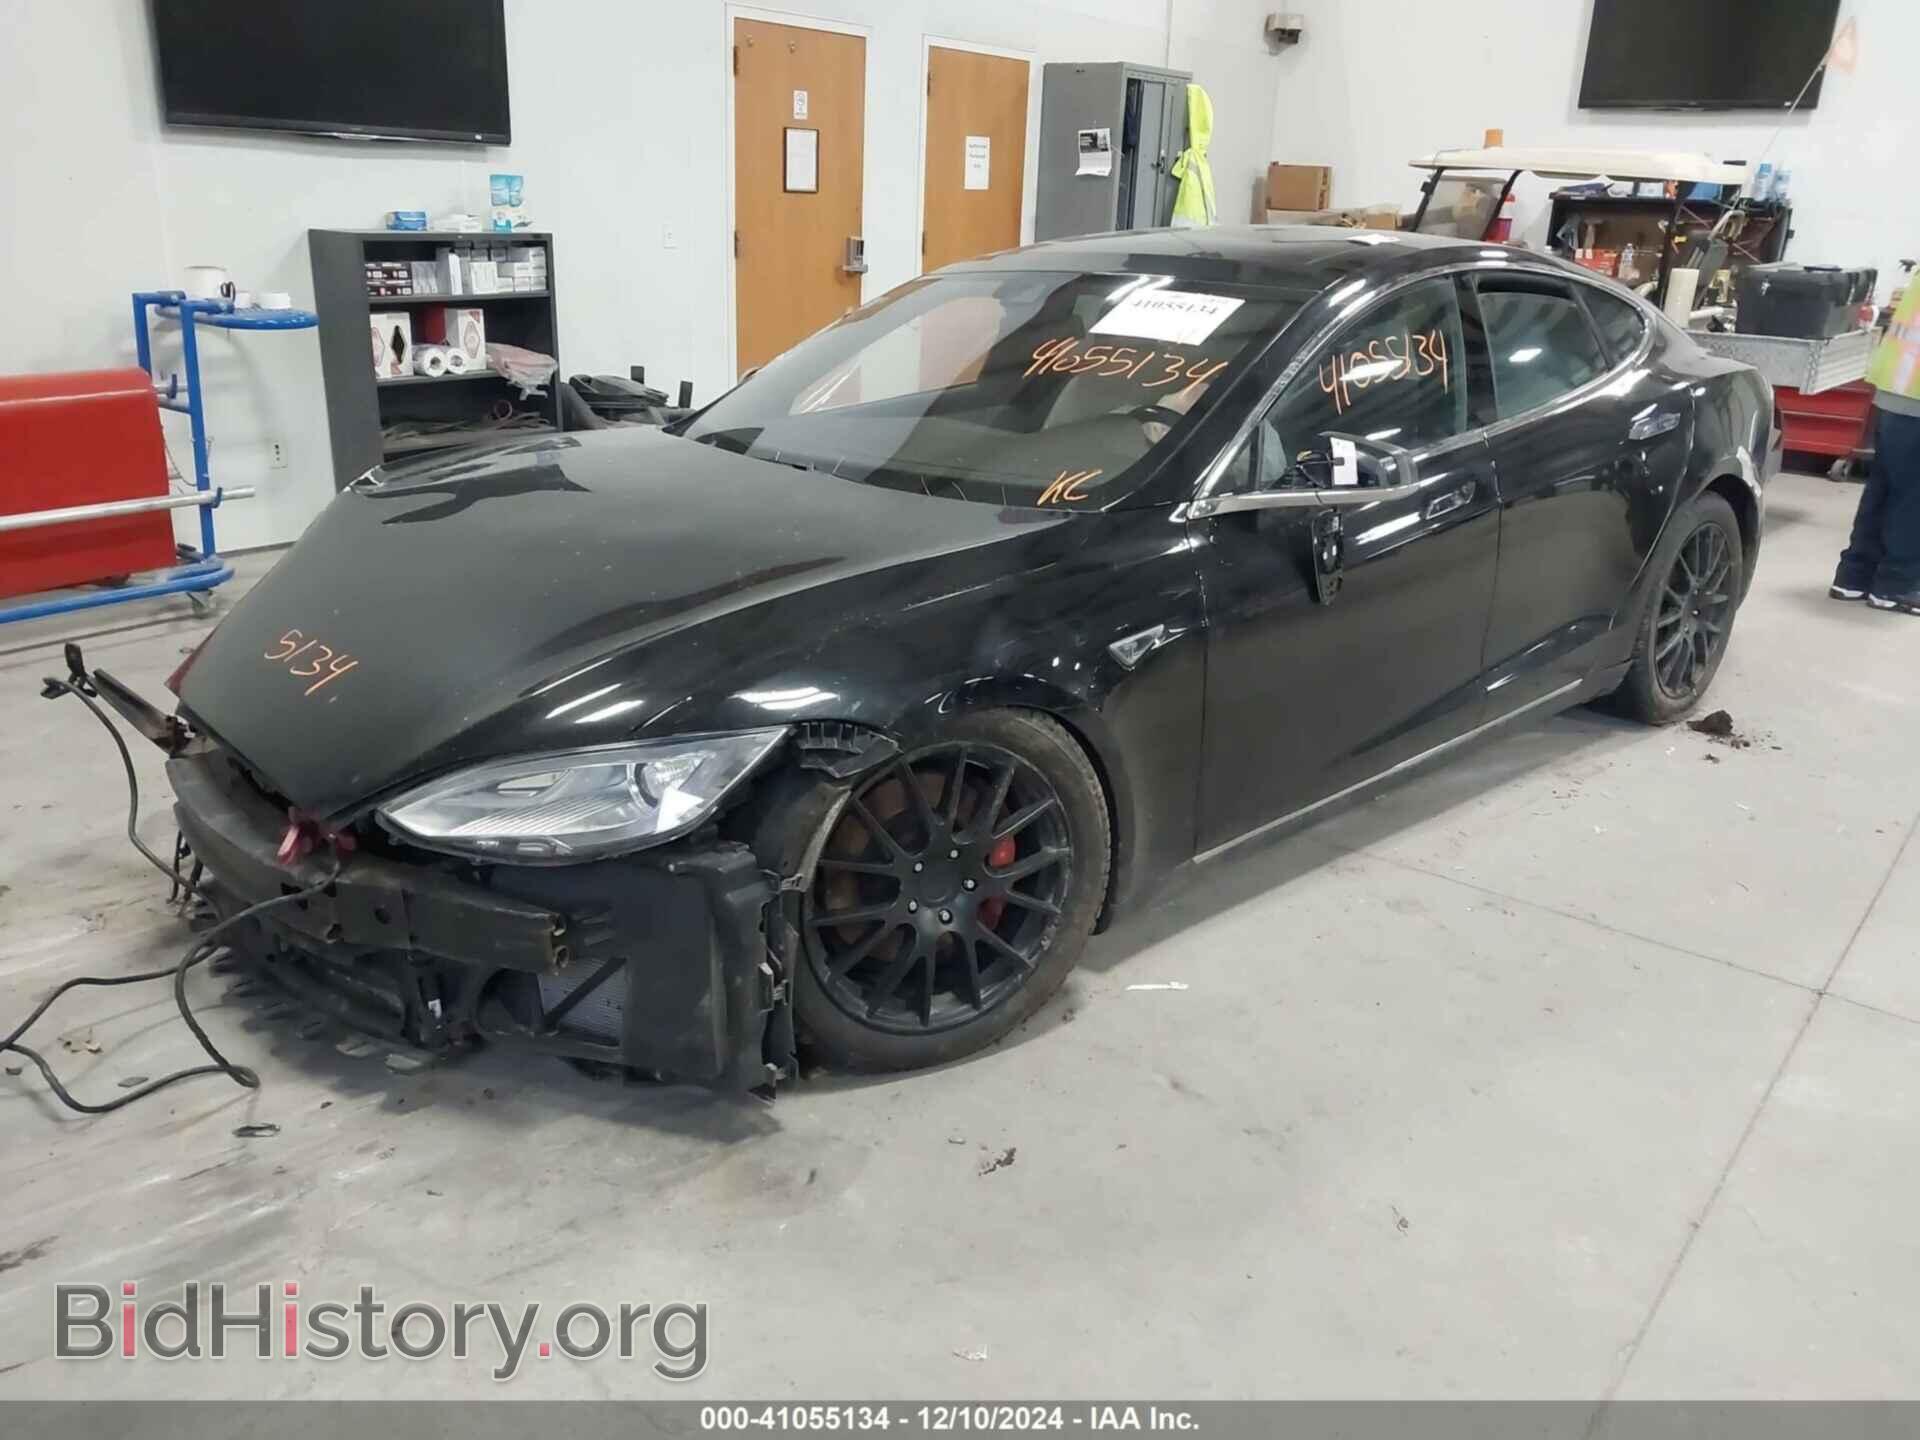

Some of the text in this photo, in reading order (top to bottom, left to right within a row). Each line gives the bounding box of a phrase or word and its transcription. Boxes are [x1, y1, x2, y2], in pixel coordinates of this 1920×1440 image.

[1022, 336, 1229, 396] 41055134
[1318, 329, 1449, 416] 41055134
[1036, 470, 1103, 506] KC
[263, 629, 359, 696] 5134
